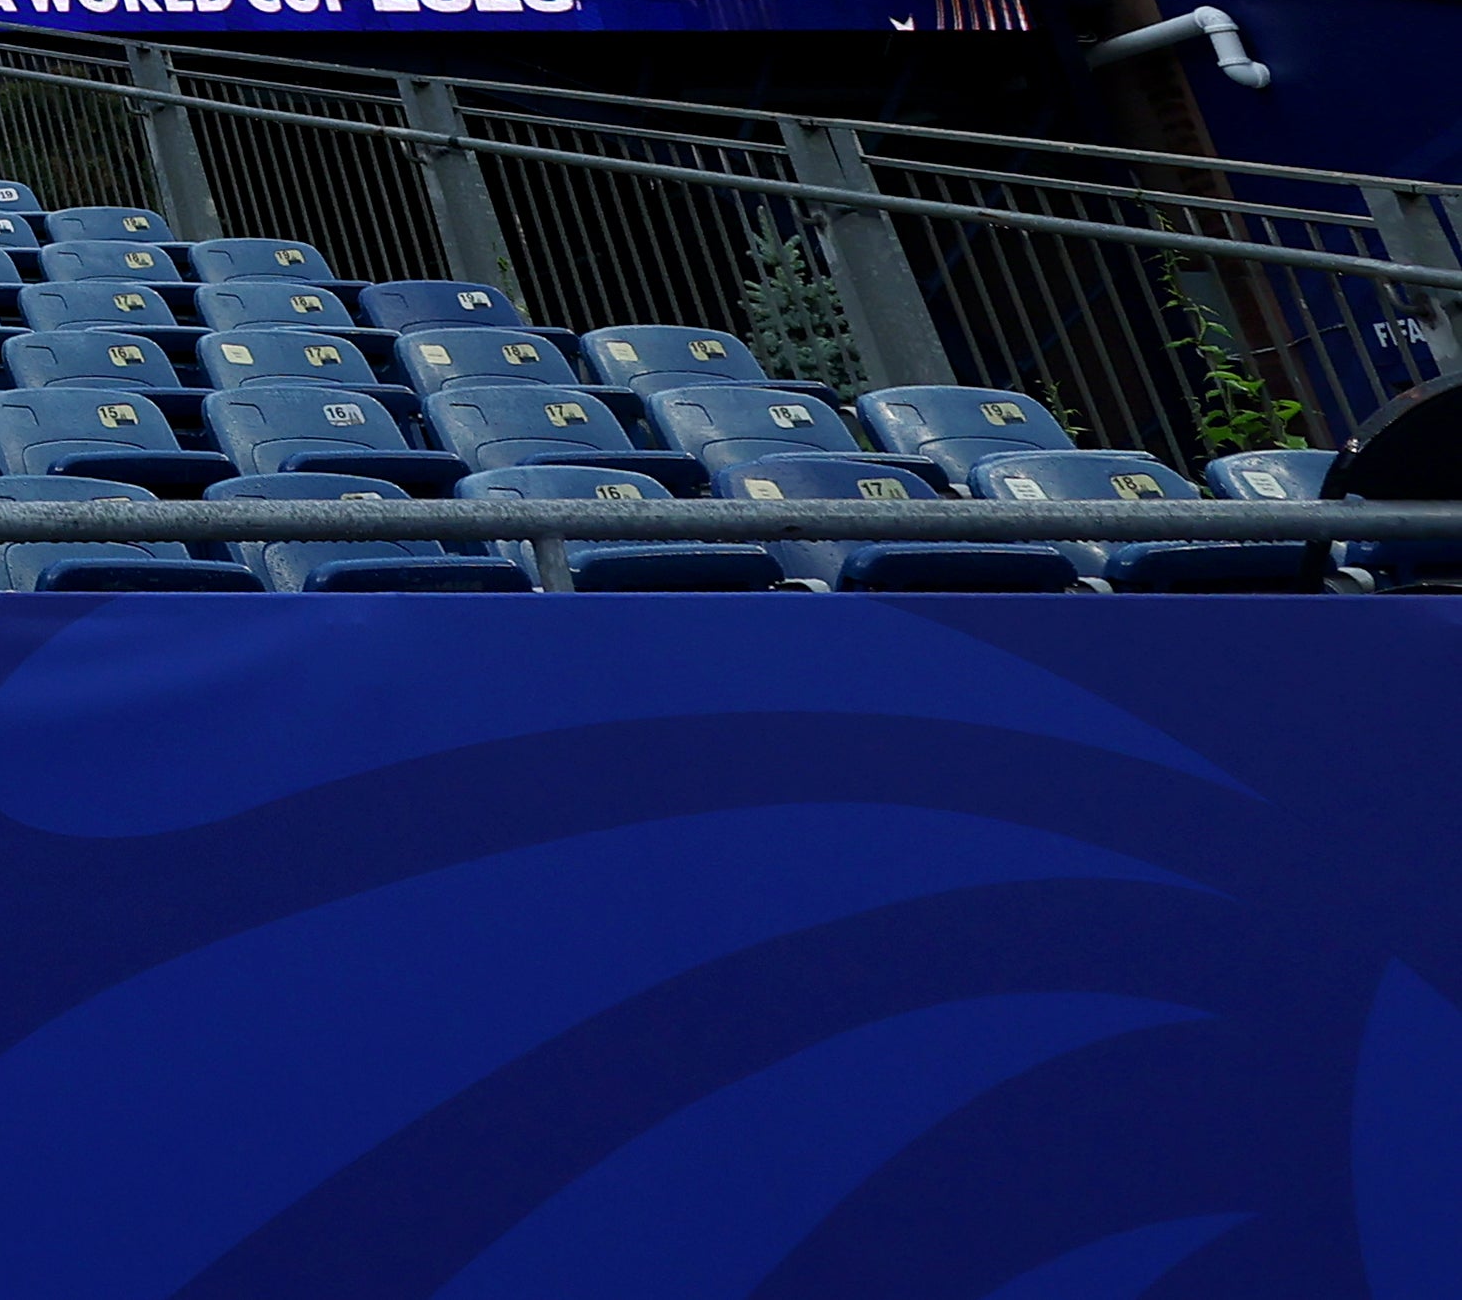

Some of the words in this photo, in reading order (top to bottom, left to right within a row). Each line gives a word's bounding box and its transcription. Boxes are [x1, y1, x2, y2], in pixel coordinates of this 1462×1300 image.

[102, 407, 118, 418] 15
[330, 408, 345, 419] 16
[548, 405, 564, 416] 17
[774, 408, 791, 419] 18
[986, 406, 1002, 416] 19
[862, 482, 881, 496] 17
[1115, 477, 1136, 491] 18
